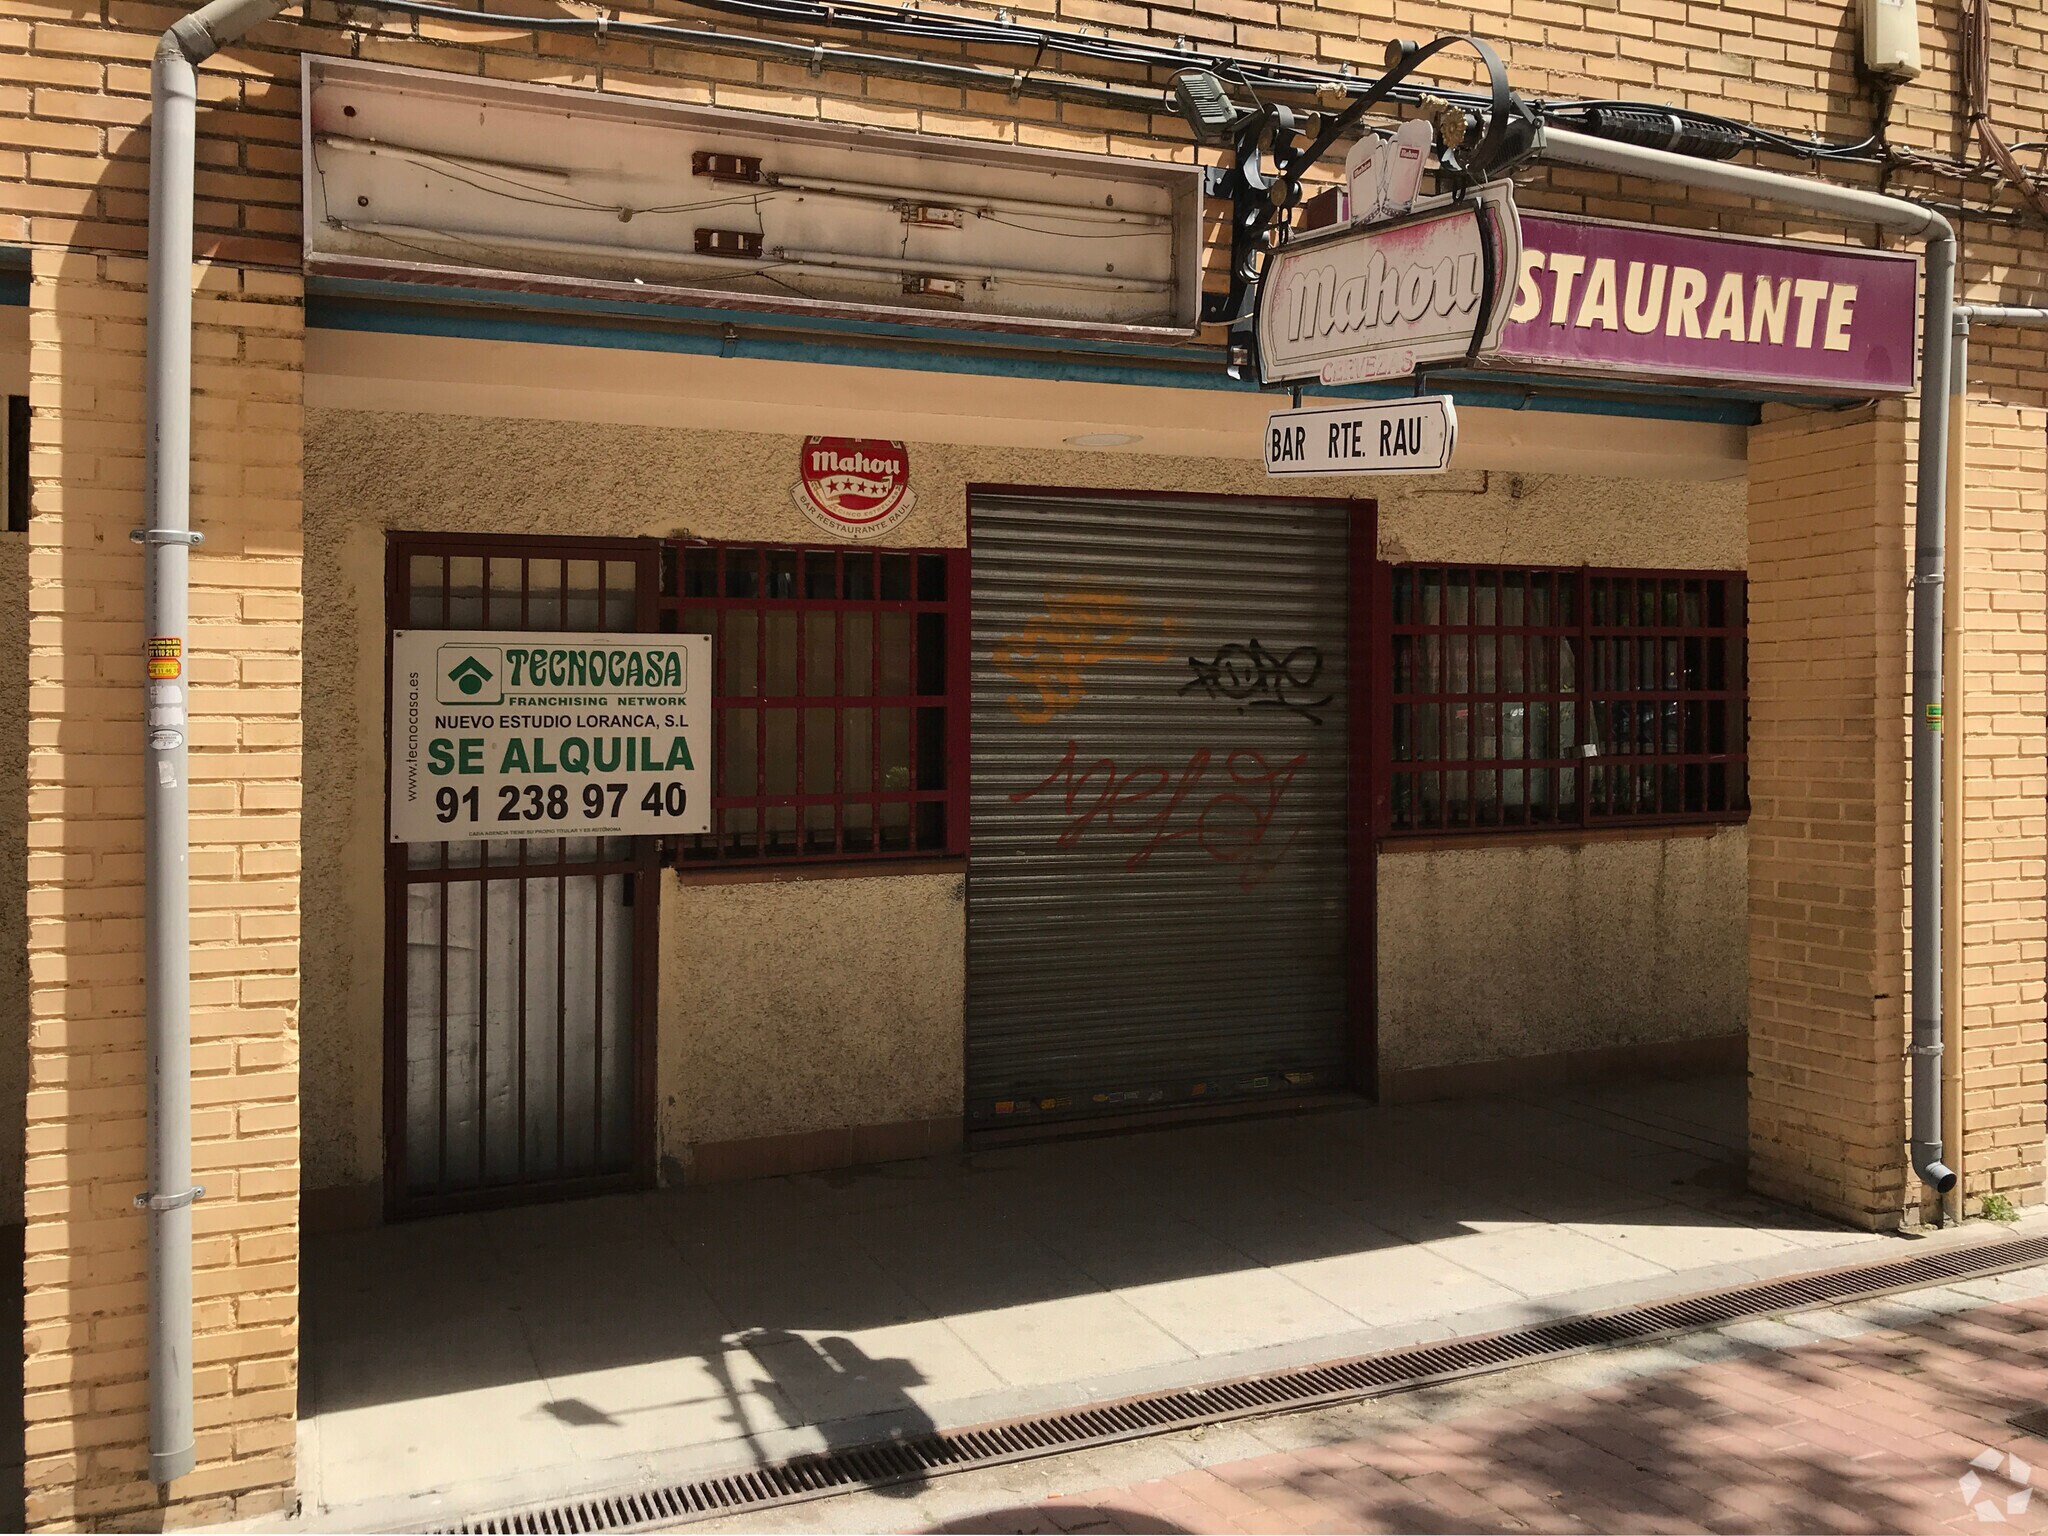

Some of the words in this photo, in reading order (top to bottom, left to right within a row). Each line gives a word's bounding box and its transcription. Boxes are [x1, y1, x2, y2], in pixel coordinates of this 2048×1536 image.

[1288, 250, 1481, 341] Mahou
[1271, 426, 1305, 463] BAR
[1328, 421, 1366, 459] RTE.
[811, 451, 900, 475] Mahou
[801, 495, 816, 514] BAR
[816, 513, 887, 534] RESTAURANTE
[889, 503, 910, 524] RAUL
[506, 649, 682, 687] TECNOCASA
[509, 697, 608, 706] FRANCHISING
[618, 697, 687, 706] NETWORK
[408, 672, 419, 802] www.tecnocasa.es
[435, 715, 494, 729] NUEVO
[500, 715, 572, 728] ESTUDIO
[577, 714, 660, 729] LORANCA,
[665, 714, 689, 728] S.L
[427, 738, 485, 776] SE
[499, 736, 695, 775] ALQUILA
[436, 786, 479, 823] 91
[497, 784, 569, 821] 238
[582, 783, 629, 819] 97
[640, 782, 687, 817] 40
